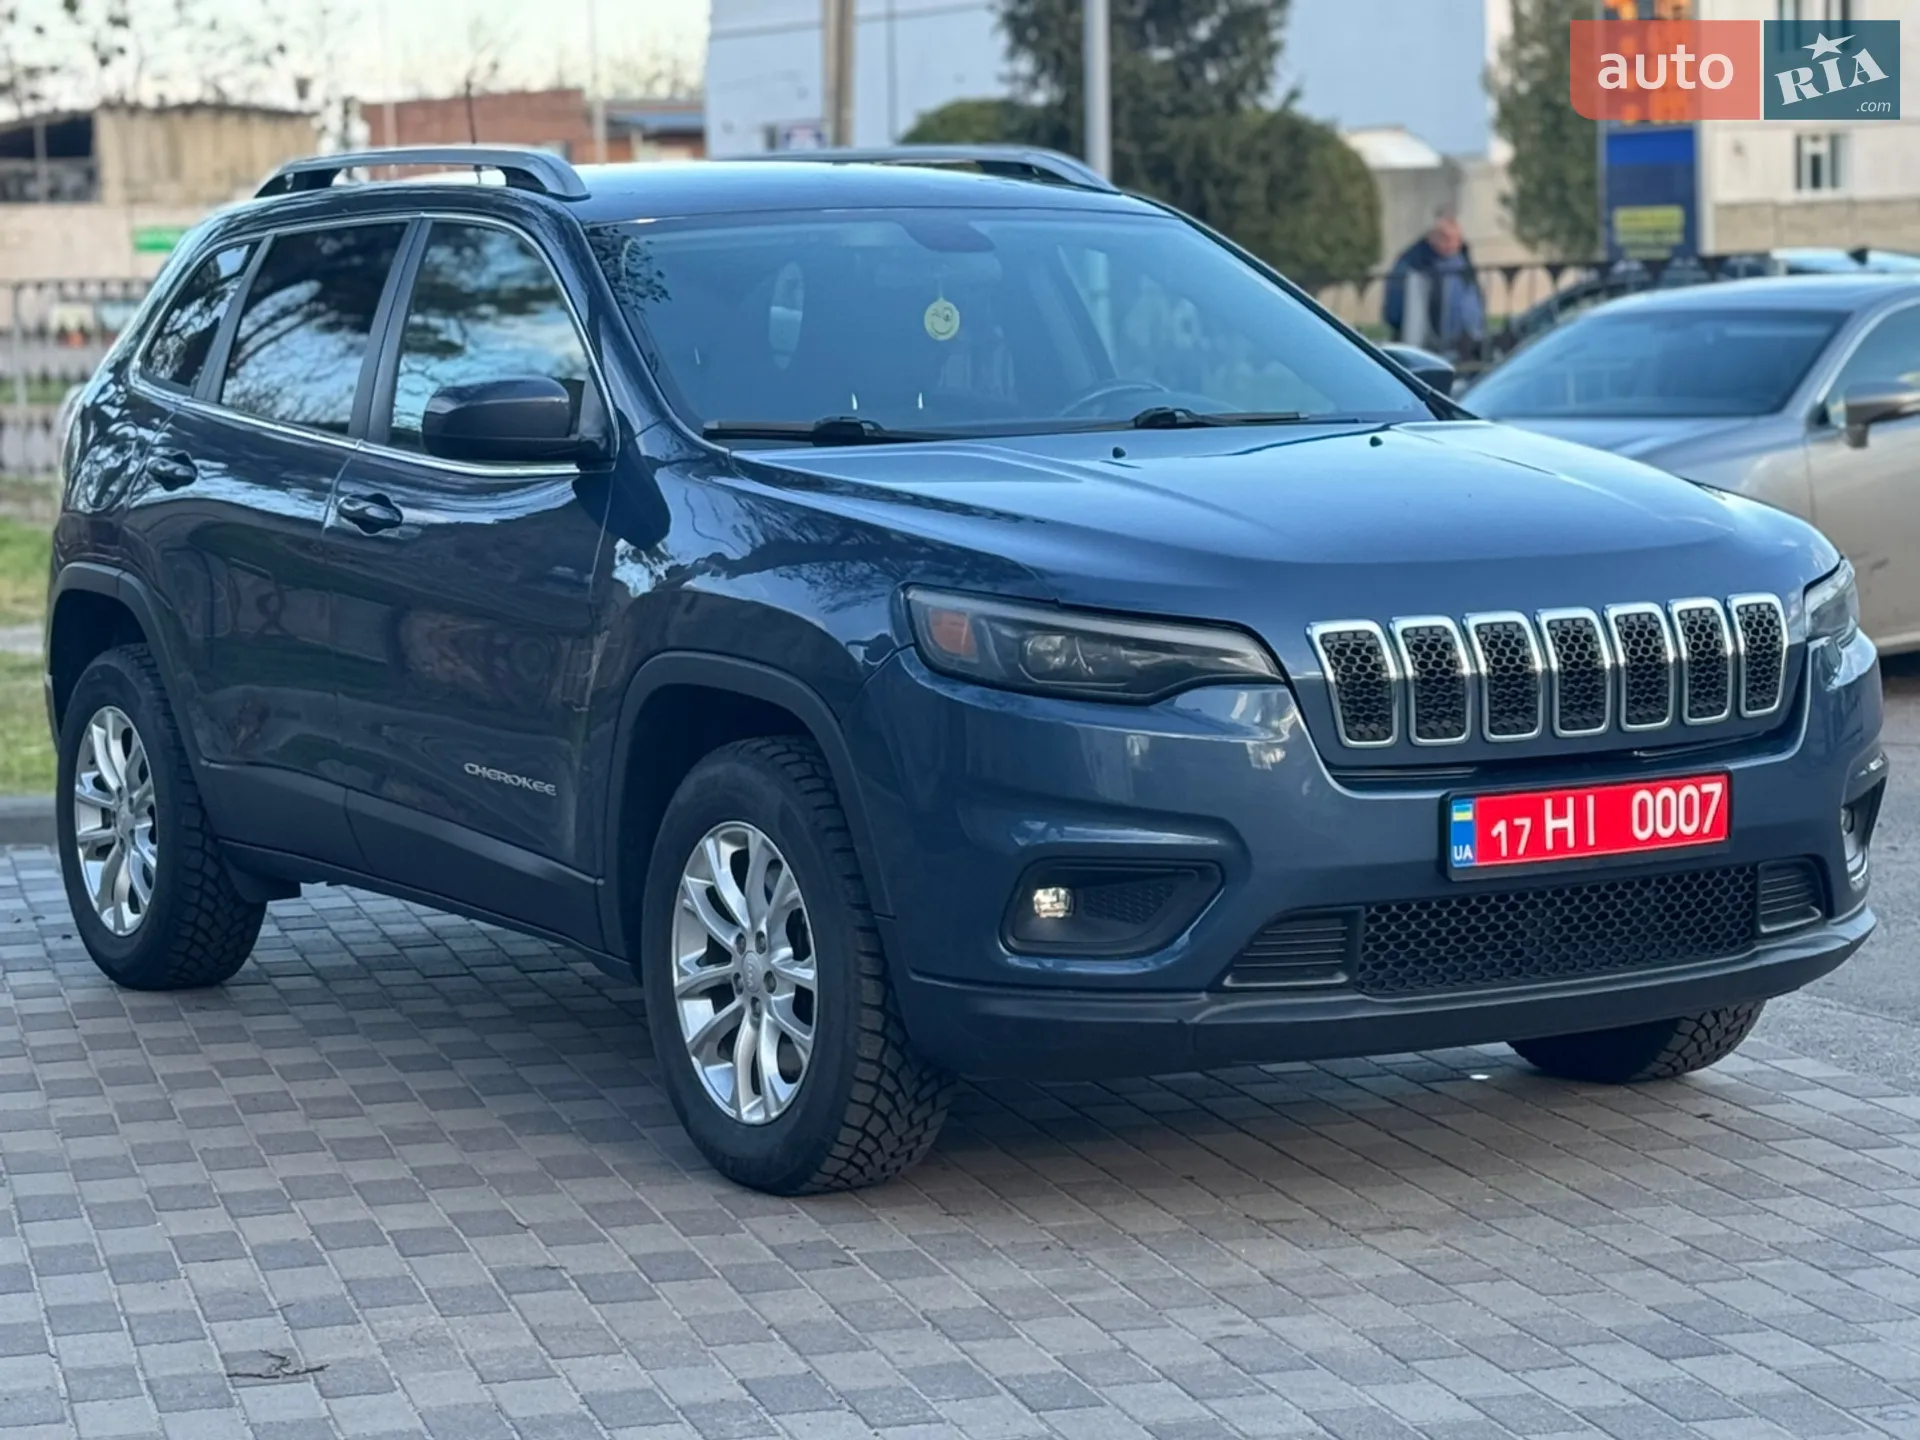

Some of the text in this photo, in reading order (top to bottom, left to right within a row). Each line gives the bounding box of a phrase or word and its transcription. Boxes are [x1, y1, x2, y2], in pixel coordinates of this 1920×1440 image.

[463, 762, 557, 796] CHEROKEE
[1491, 782, 1723, 857] 17 HI 0007
[1453, 844, 1473, 861] UA
